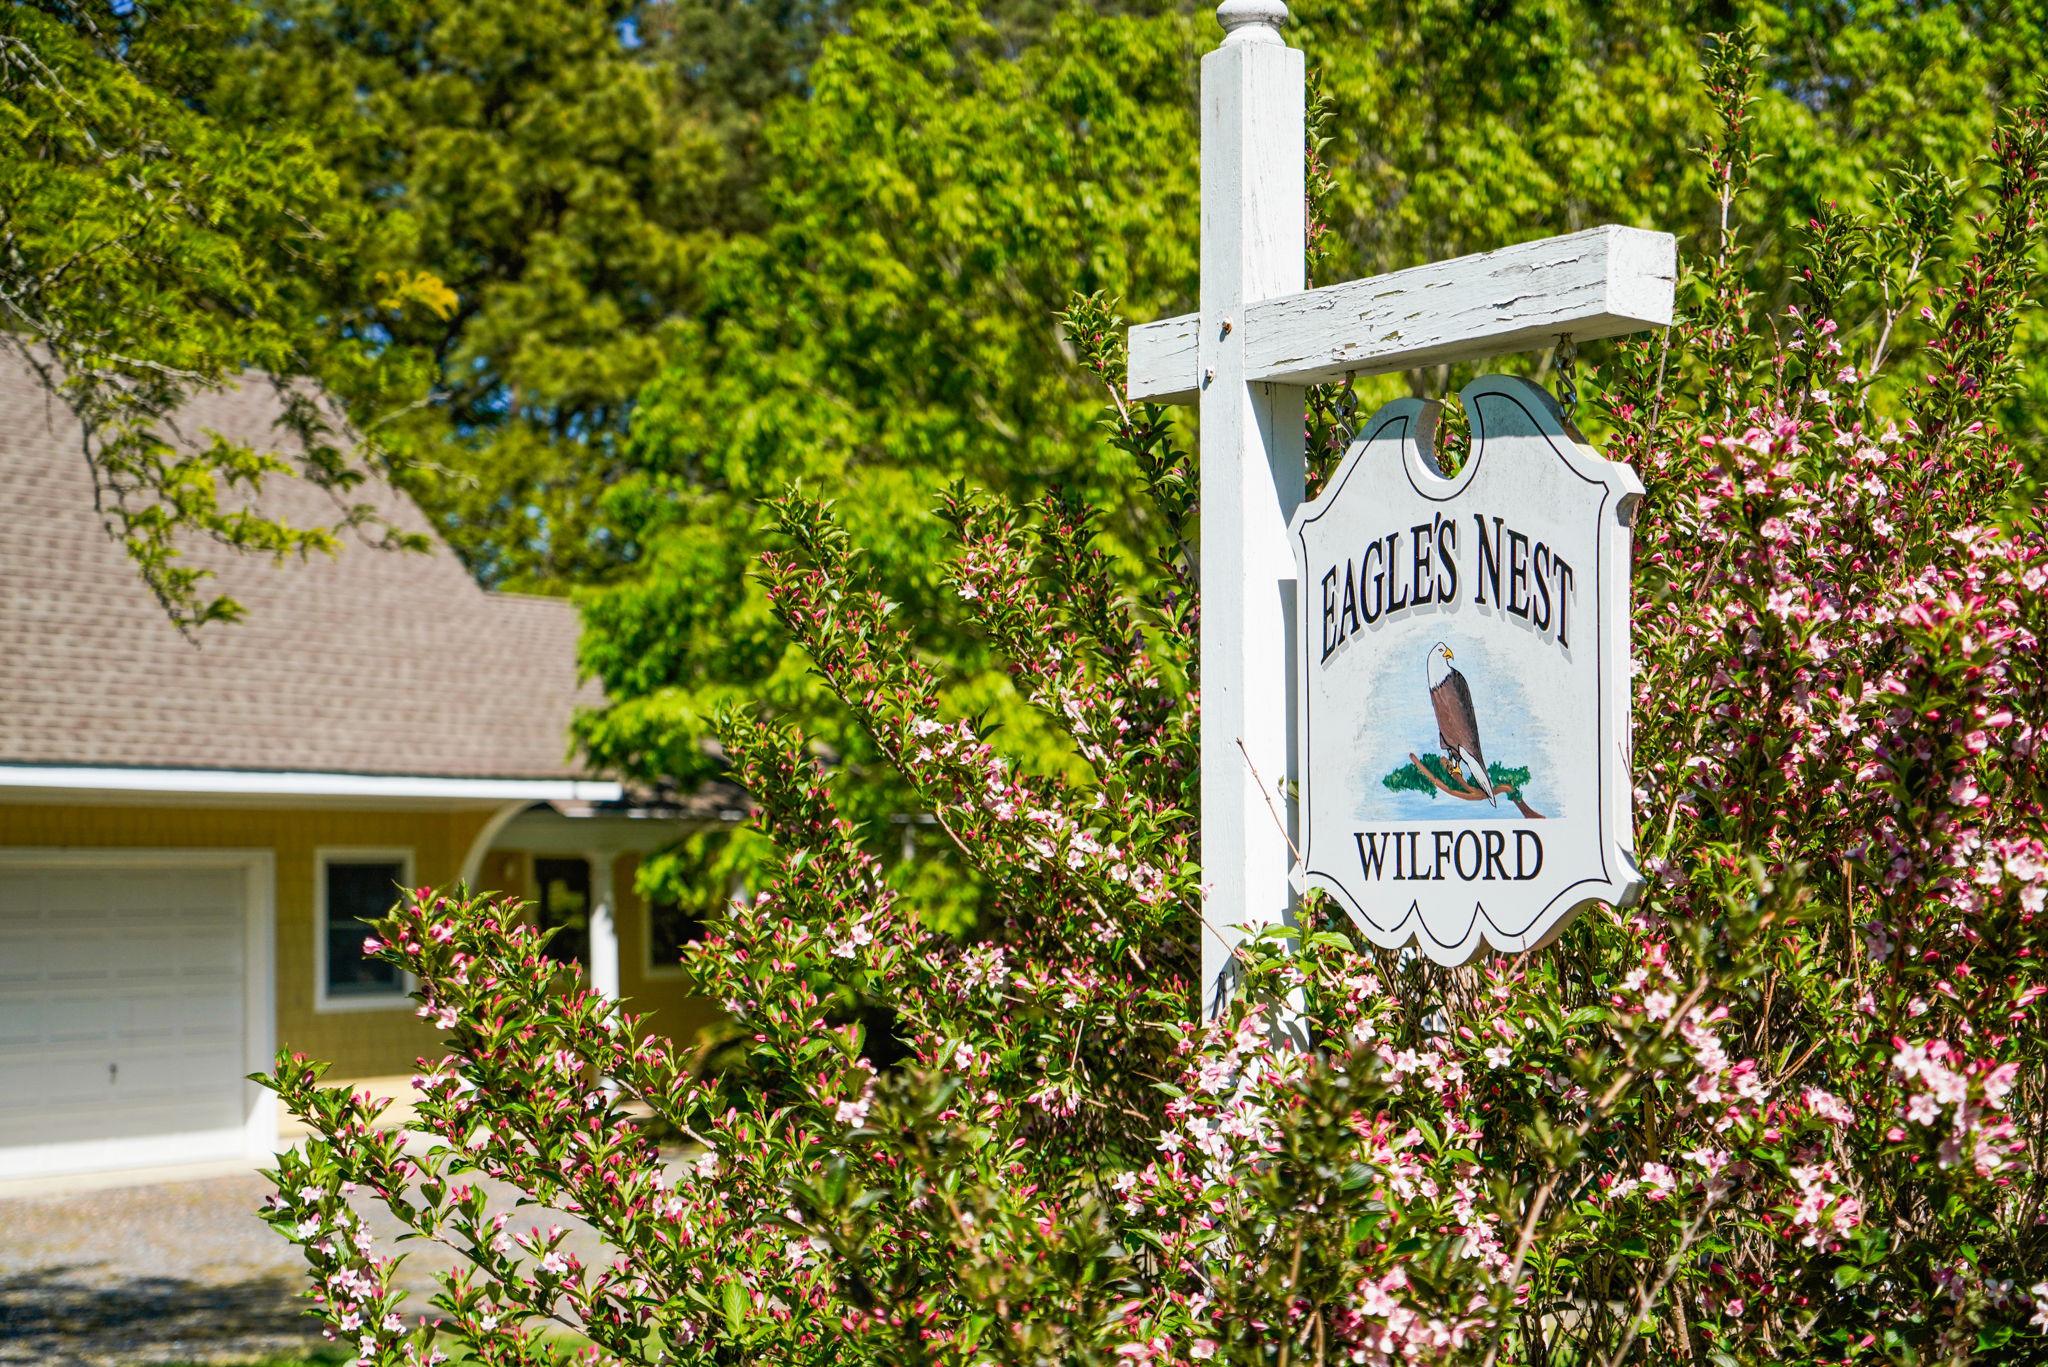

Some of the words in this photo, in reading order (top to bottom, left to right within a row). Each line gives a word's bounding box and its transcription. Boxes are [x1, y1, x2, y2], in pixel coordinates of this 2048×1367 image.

[1321, 512, 1458, 665] EAGLE'S
[1474, 514, 1575, 649] NEST
[1354, 829, 1544, 882] WILFORD
